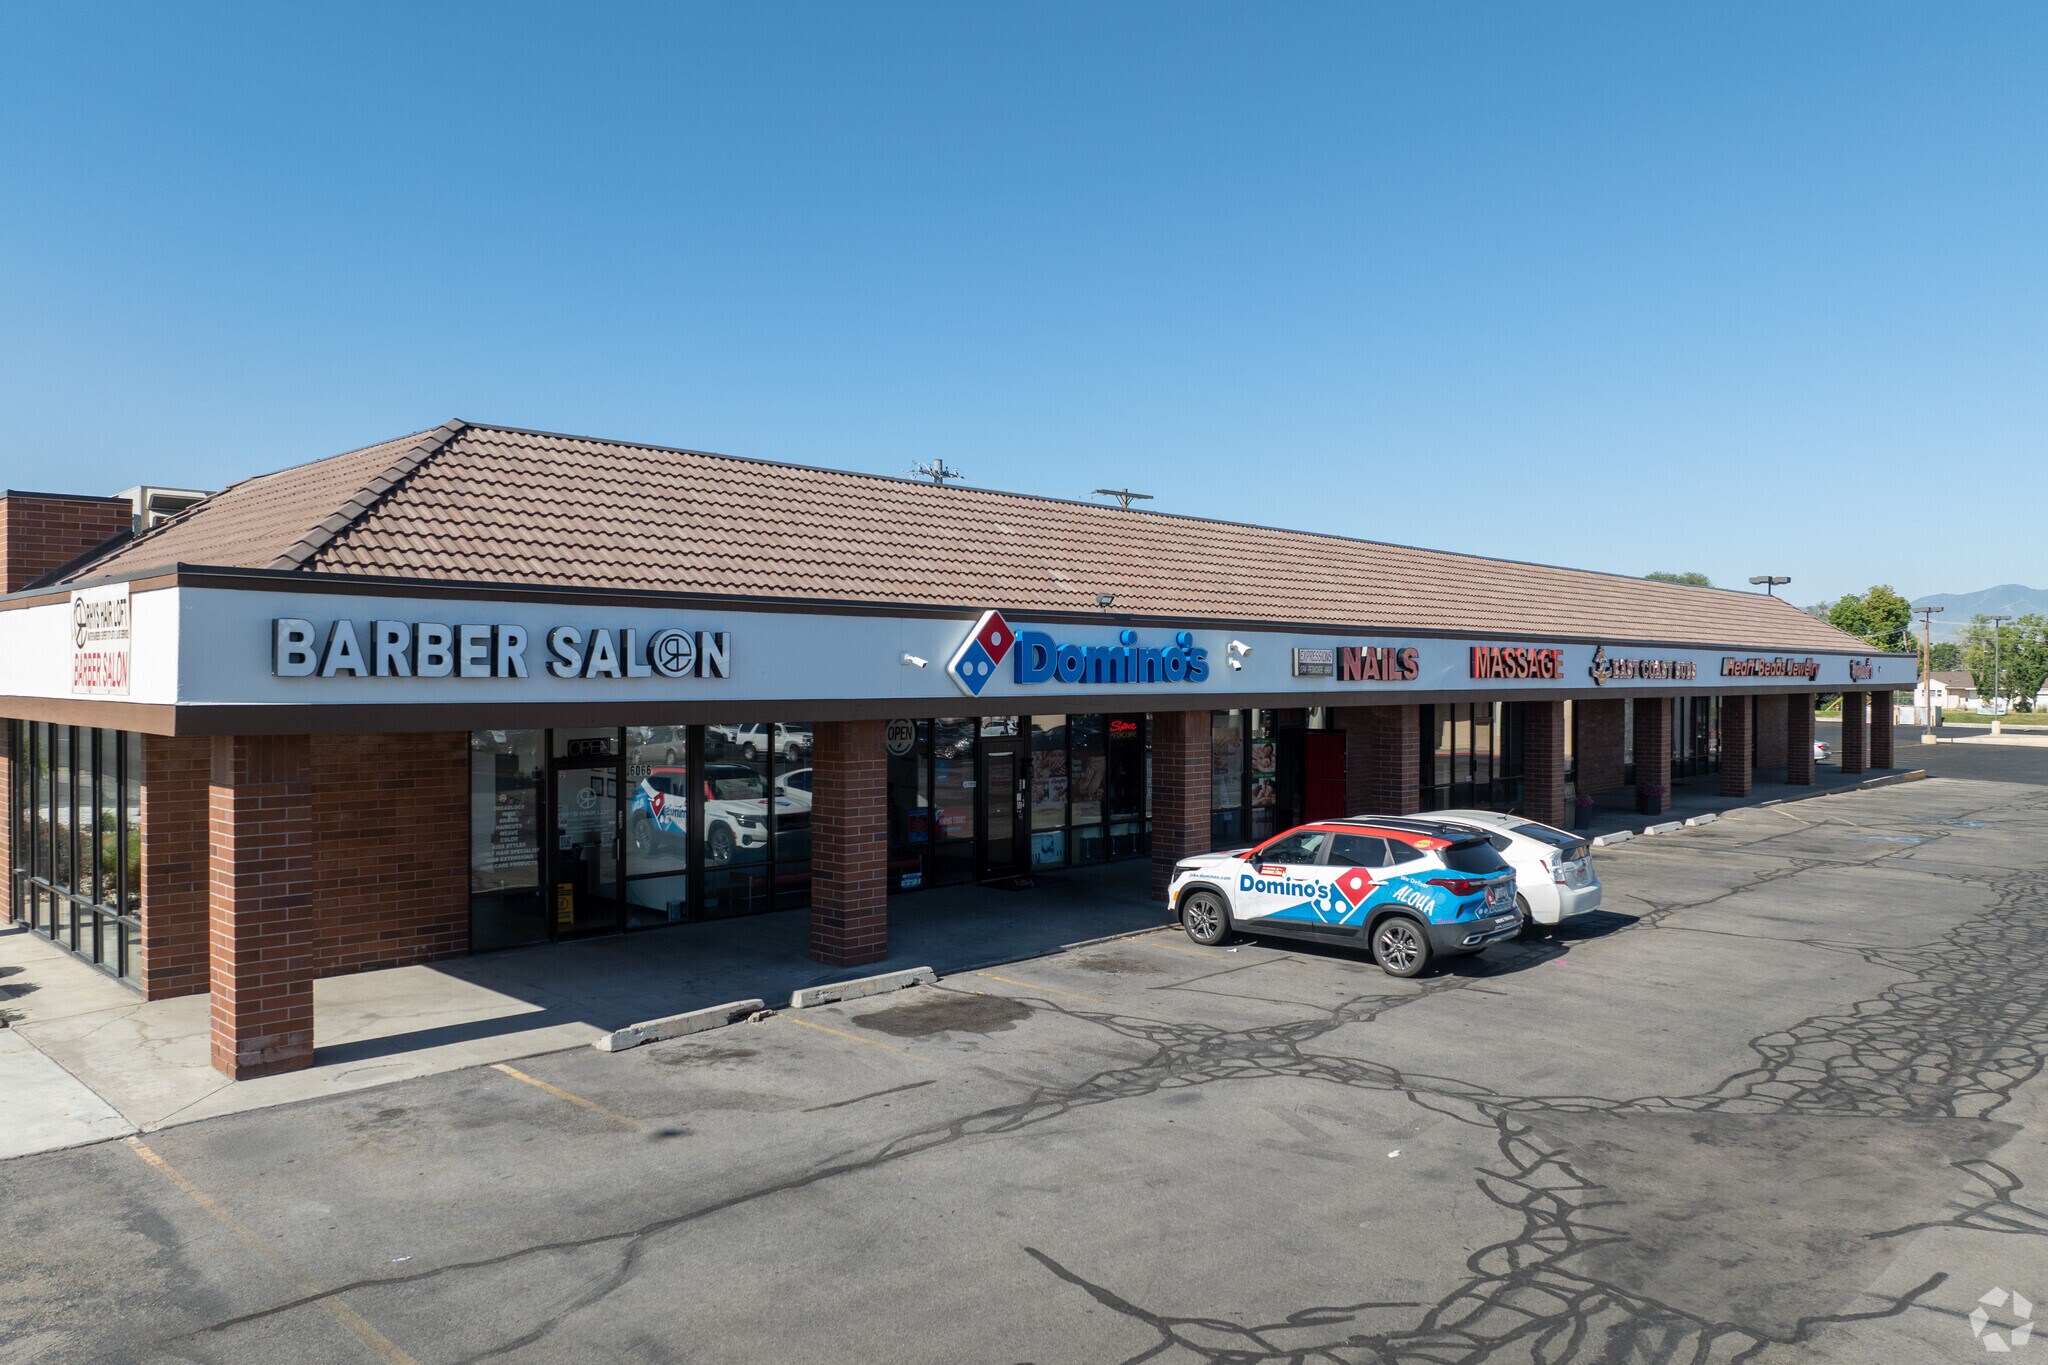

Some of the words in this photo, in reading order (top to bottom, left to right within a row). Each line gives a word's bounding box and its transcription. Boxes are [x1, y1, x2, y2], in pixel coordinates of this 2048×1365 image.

[114, 599, 128, 626] LOFT
[272, 618, 530, 679] BARBER
[546, 625, 731, 680] SALON
[1014, 630, 1209, 685] Domino's
[1300, 650, 1333, 663] EXPRESSIONS
[74, 652, 101, 687] BARBER
[103, 651, 128, 688] SALON
[1338, 646, 1419, 681] NAILS
[1470, 645, 1564, 680] MASSAGE
[1611, 658, 1639, 679] EAST
[1641, 659, 1673, 679] COAST
[1721, 657, 1755, 677] Heart
[1755, 657, 1786, 677] Beads
[1786, 658, 1820, 682] Jewelry
[887, 726, 913, 741] OPEN
[1109, 720, 1137, 732] Spa
[630, 765, 652, 776] 6066
[500, 854, 534, 862] EXTENSIONS
[510, 847, 540, 855] SPECIALIST
[1188, 872, 1232, 881] jobs.dominos.com
[1240, 874, 1329, 899] Domino's
[1393, 885, 1436, 917] ALOHA
